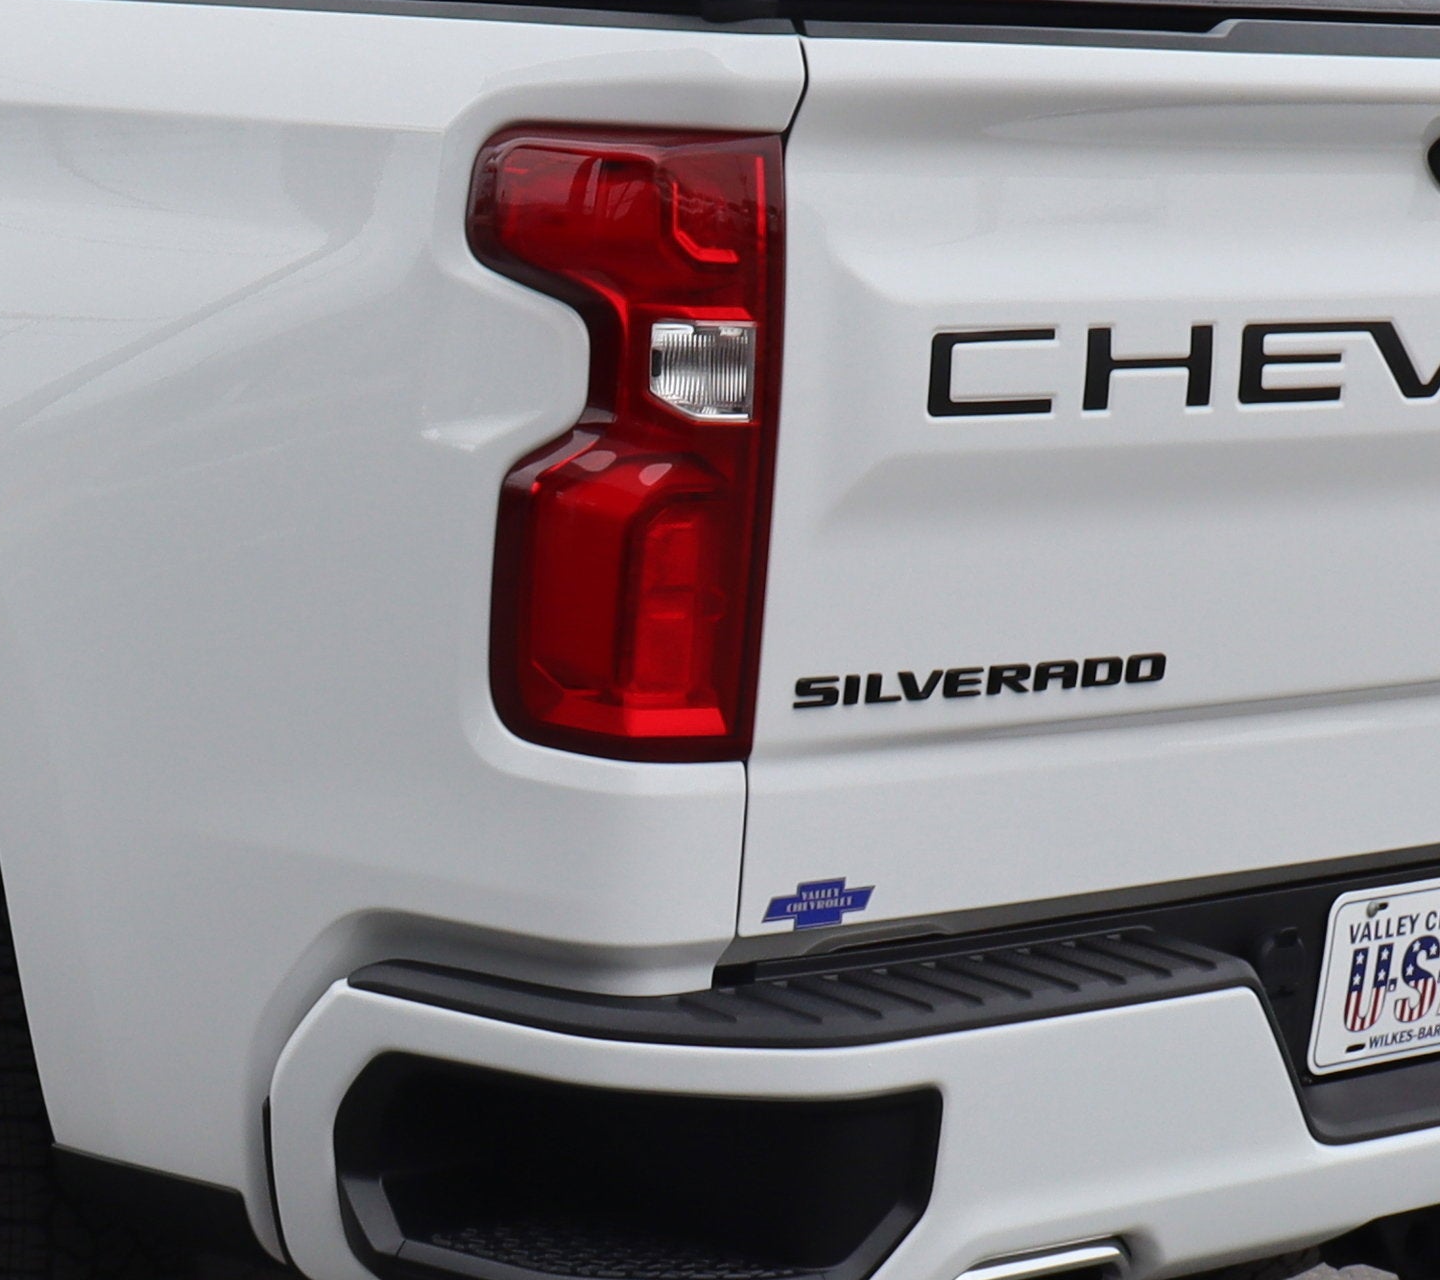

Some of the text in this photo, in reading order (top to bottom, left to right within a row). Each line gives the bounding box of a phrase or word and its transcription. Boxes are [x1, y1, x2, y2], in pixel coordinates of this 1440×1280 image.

[792, 651, 1167, 710] SILVERADO
[785, 895, 854, 913] CHEVROLET
[801, 888, 840, 901] VALLEY
[1348, 912, 1421, 945] VALLEY
